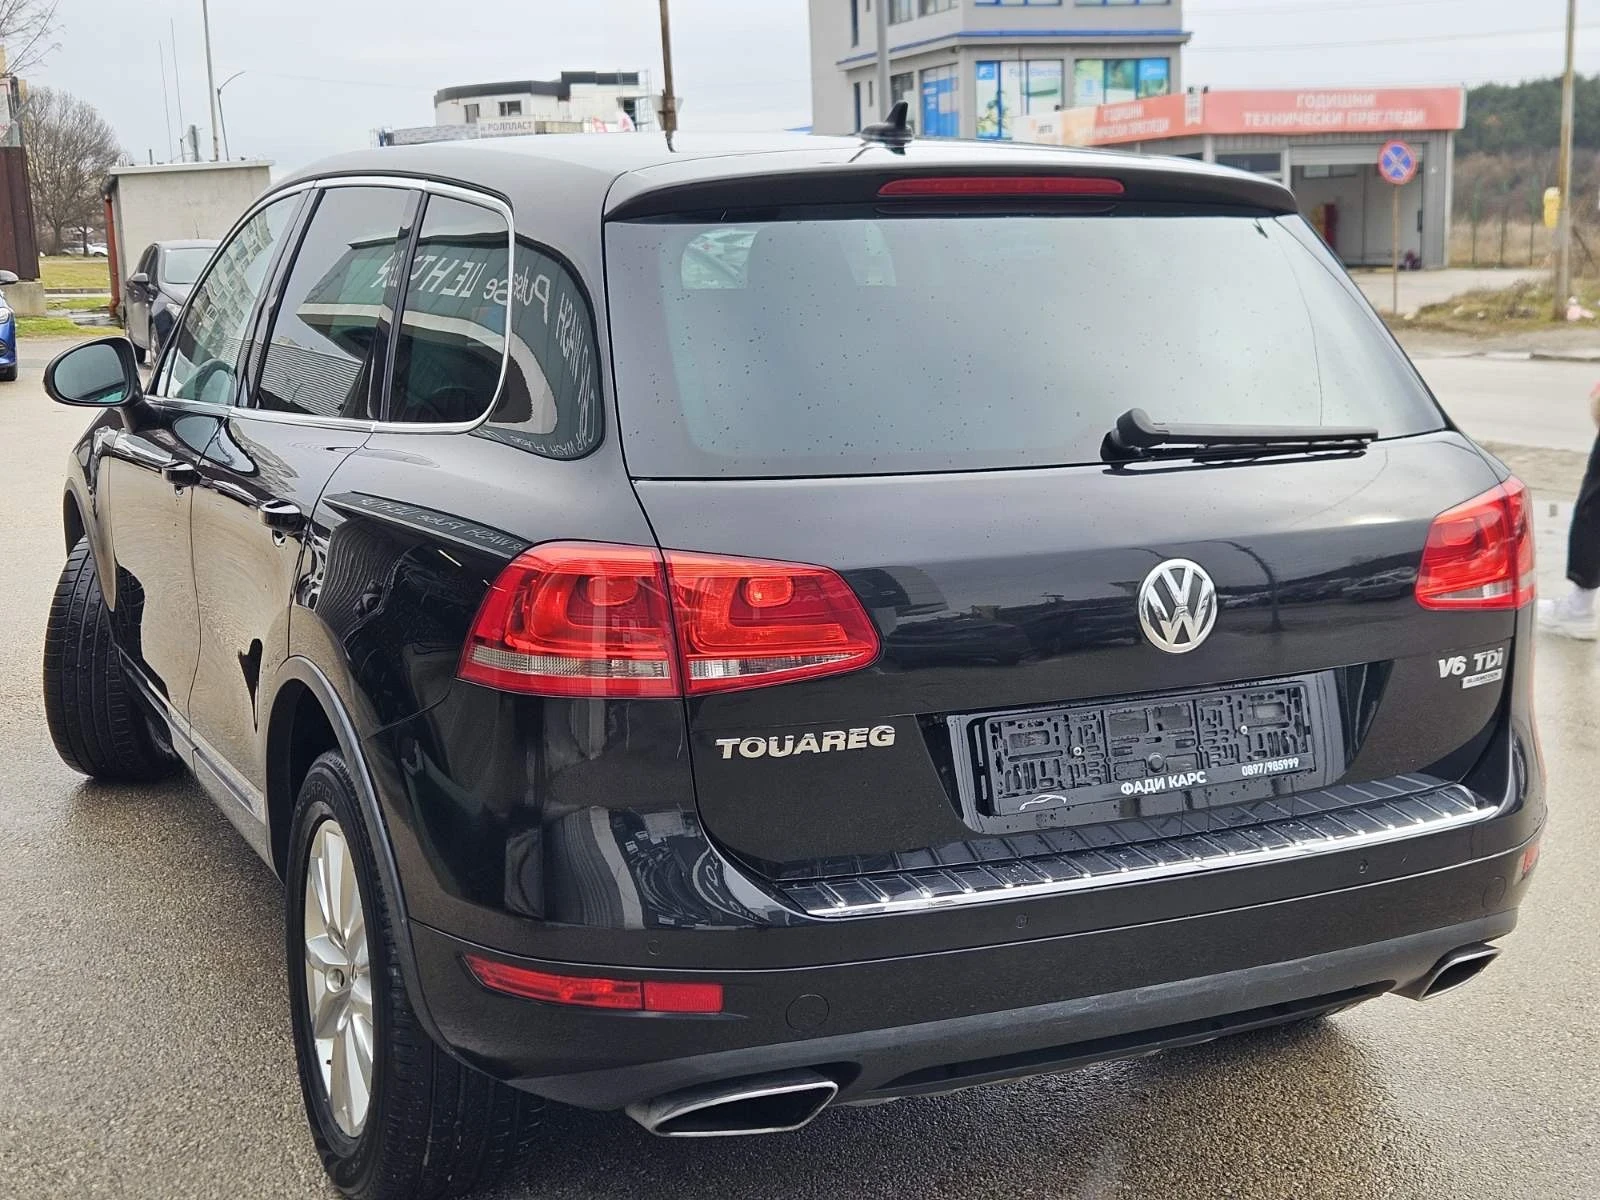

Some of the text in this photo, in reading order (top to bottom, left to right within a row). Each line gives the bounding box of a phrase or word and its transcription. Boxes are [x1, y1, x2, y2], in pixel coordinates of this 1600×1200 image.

[1296, 92, 1377, 108] ГОДИШНИ
[1244, 108, 1426, 126] ТЕХНИЧЕСКИ ПРЕГЛЕДИ
[1438, 655, 1467, 678] V6
[715, 725, 896, 759] TOUAREG
[1241, 756, 1300, 777] 0897/985999
[1120, 771, 1208, 795] ФАДИ КАРС
